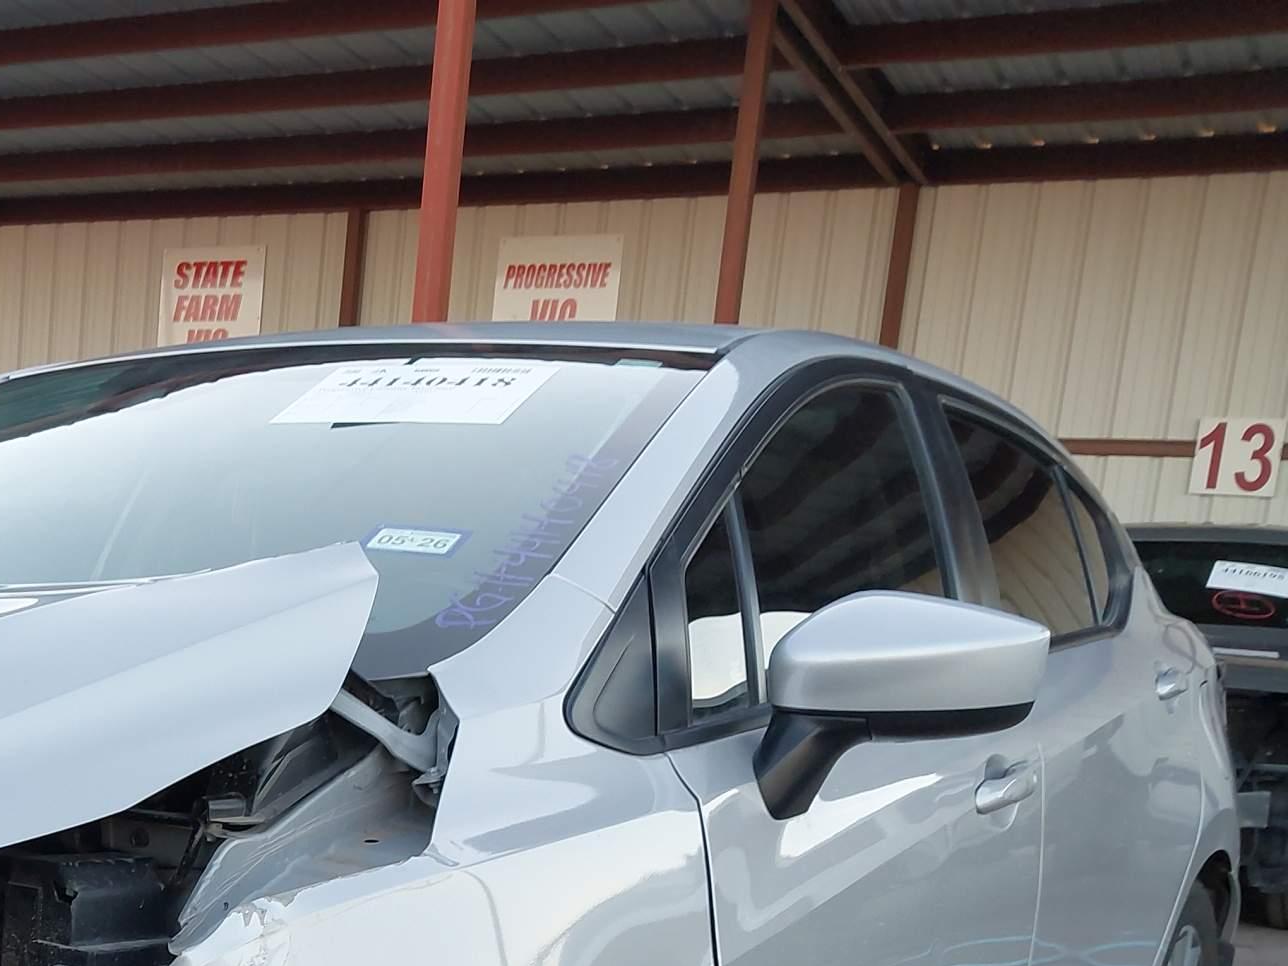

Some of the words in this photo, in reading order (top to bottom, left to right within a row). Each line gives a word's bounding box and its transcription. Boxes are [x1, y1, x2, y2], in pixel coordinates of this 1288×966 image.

[173, 259, 247, 289] STATE
[503, 262, 612, 289] PROGRESSIVE
[172, 294, 243, 322] FARM
[1198, 421, 1275, 492] 13
[416, 537, 450, 549] 26
